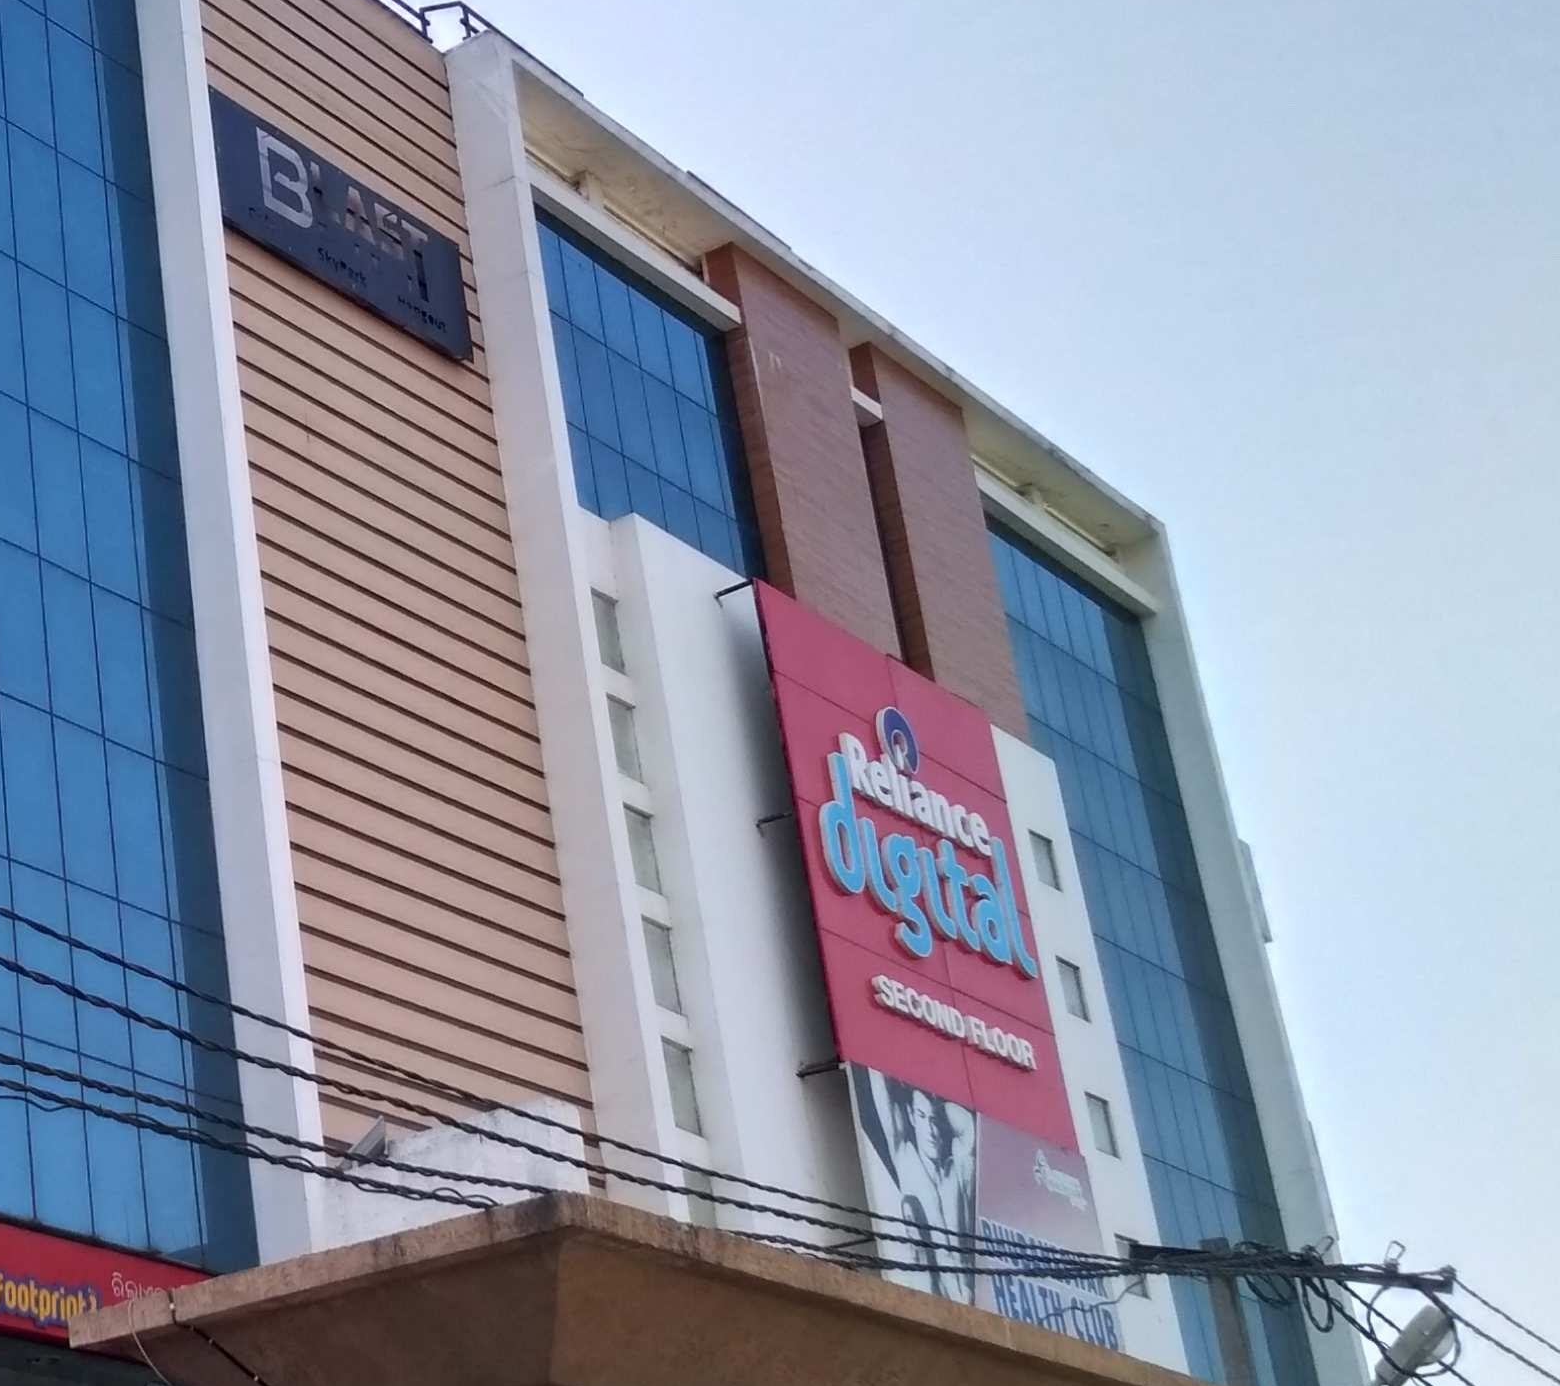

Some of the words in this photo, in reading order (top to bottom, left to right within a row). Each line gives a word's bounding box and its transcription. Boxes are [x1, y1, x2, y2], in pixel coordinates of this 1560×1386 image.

[838, 731, 993, 859] Reliance
[819, 748, 1038, 980] digital
[872, 973, 966, 1040] SECOND
[965, 1012, 1038, 1072] FLOOR
[991, 1273, 1068, 1337] HEALTH
[1071, 1297, 1120, 1352] CLUB
